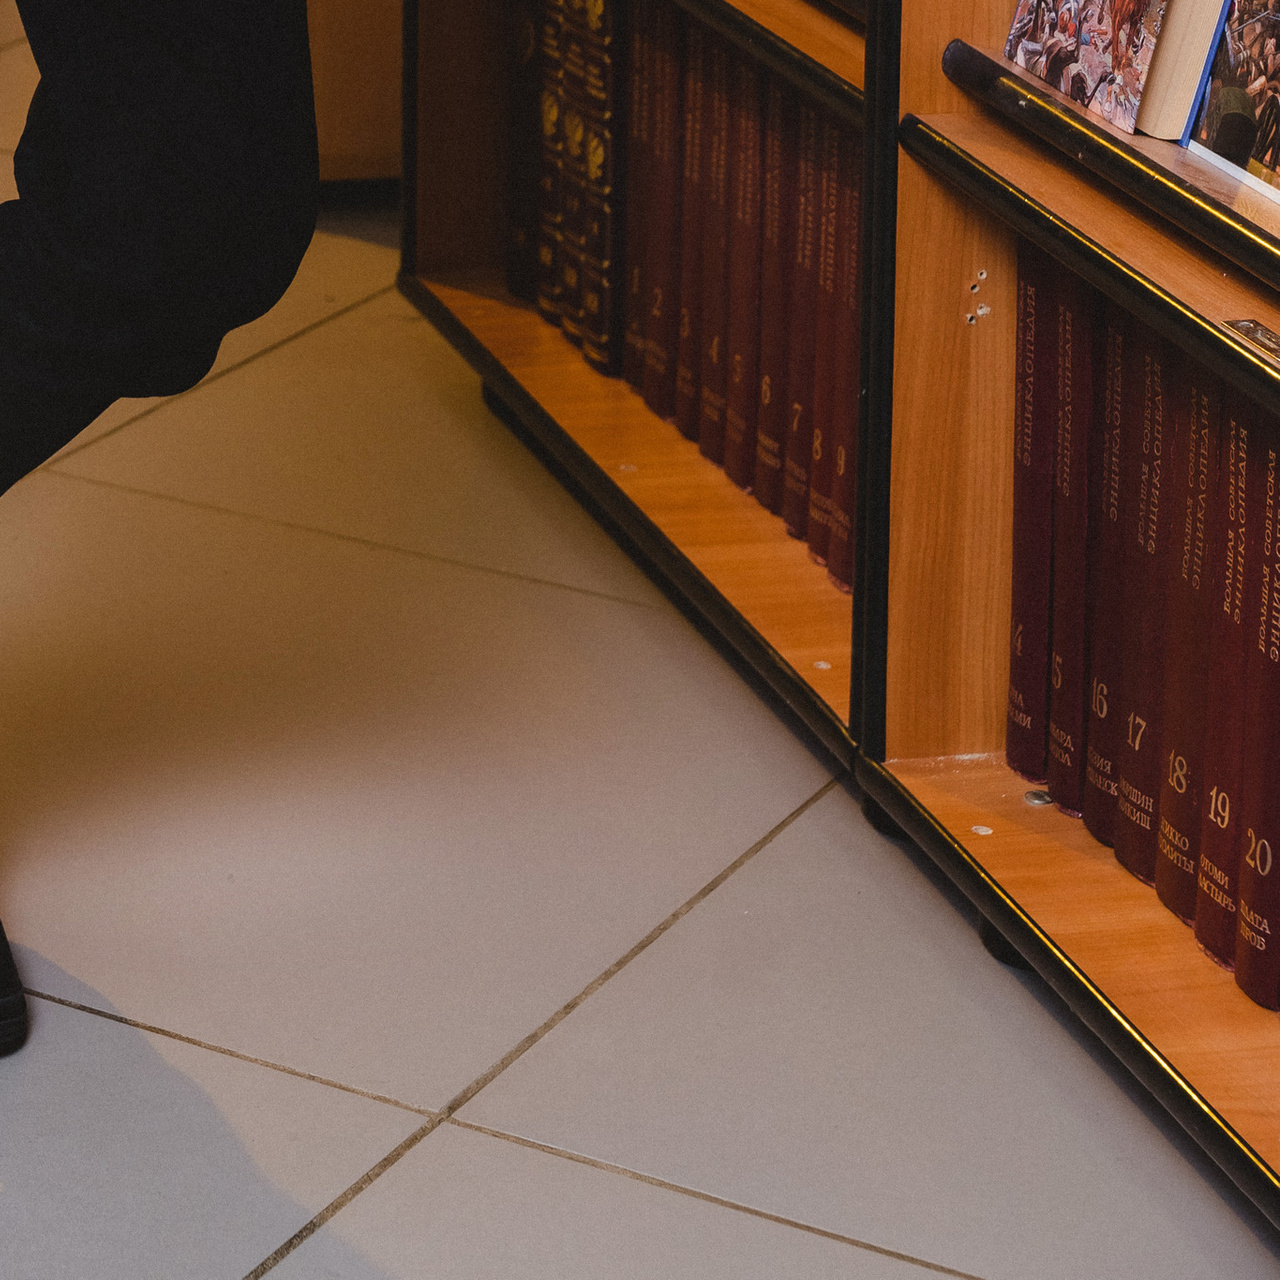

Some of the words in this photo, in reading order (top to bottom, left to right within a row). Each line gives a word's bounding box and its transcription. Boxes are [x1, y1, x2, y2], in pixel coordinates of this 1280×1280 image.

[652, 288, 662, 317] 2
[793, 402, 802, 432] 7
[812, 428, 822, 460] 8
[1148, 361, 1161, 554] ЭНЦИКЛОПЕДИЯ
[1191, 395, 1208, 589] ЭНЦИКЛОПЕДИЯ
[1263, 450, 1276, 556] СОВЕТСКАЯ
[1182, 496, 1193, 580] БОЛЬШАЯ
[1224, 530, 1234, 615] БОЛЬШАЯ
[1229, 418, 1237, 521] СОВЕТСКАЯ
[1234, 426, 1247, 624] ЭНЦИКЛОПЕДИЯ
[1258, 565, 1270, 653] БОЛЬШАЯ
[1091, 677, 1108, 718] 16
[1126, 711, 1147, 751] 17
[1168, 749, 1187, 793] 18
[1208, 785, 1230, 829] 19
[1245, 828, 1272, 876] 20
